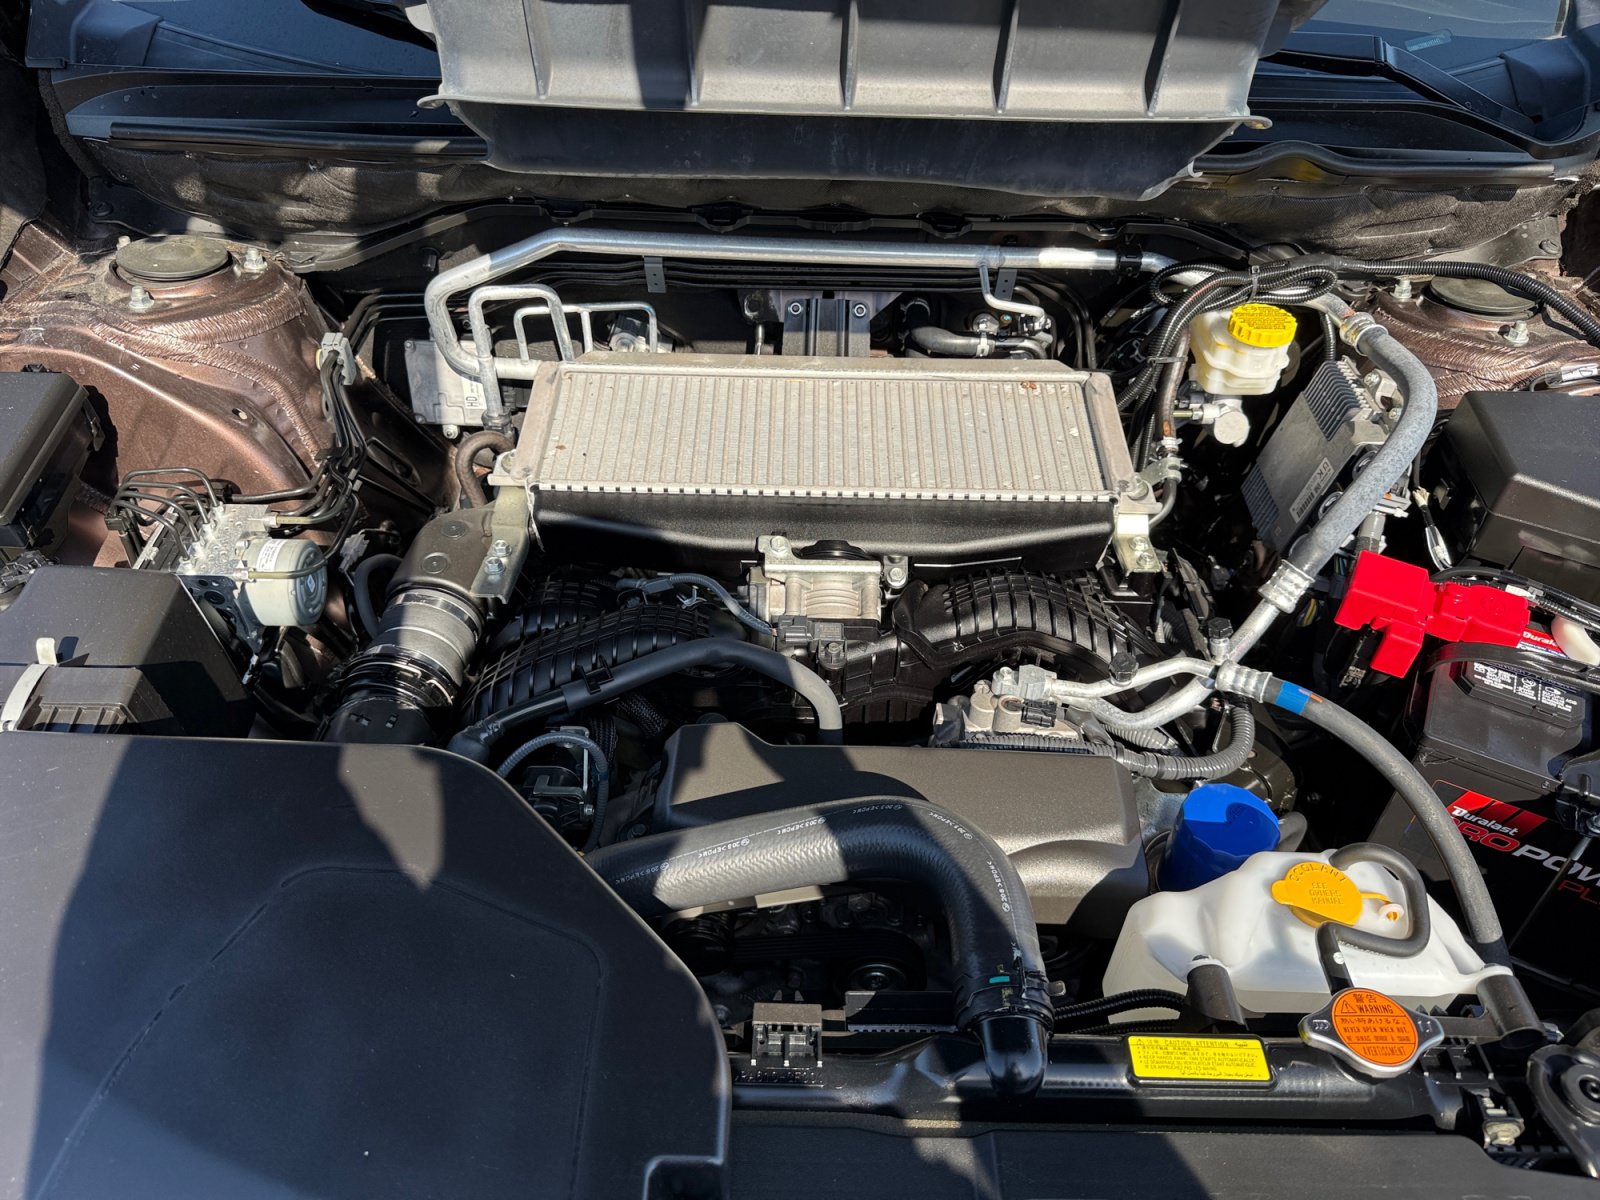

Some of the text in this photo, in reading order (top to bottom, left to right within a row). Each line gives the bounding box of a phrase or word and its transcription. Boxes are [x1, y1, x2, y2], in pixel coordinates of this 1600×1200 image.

[1452, 806, 1518, 836] Duralast
[1289, 864, 1346, 881] COOLANT
[1356, 1004, 1393, 1014] WARNING
